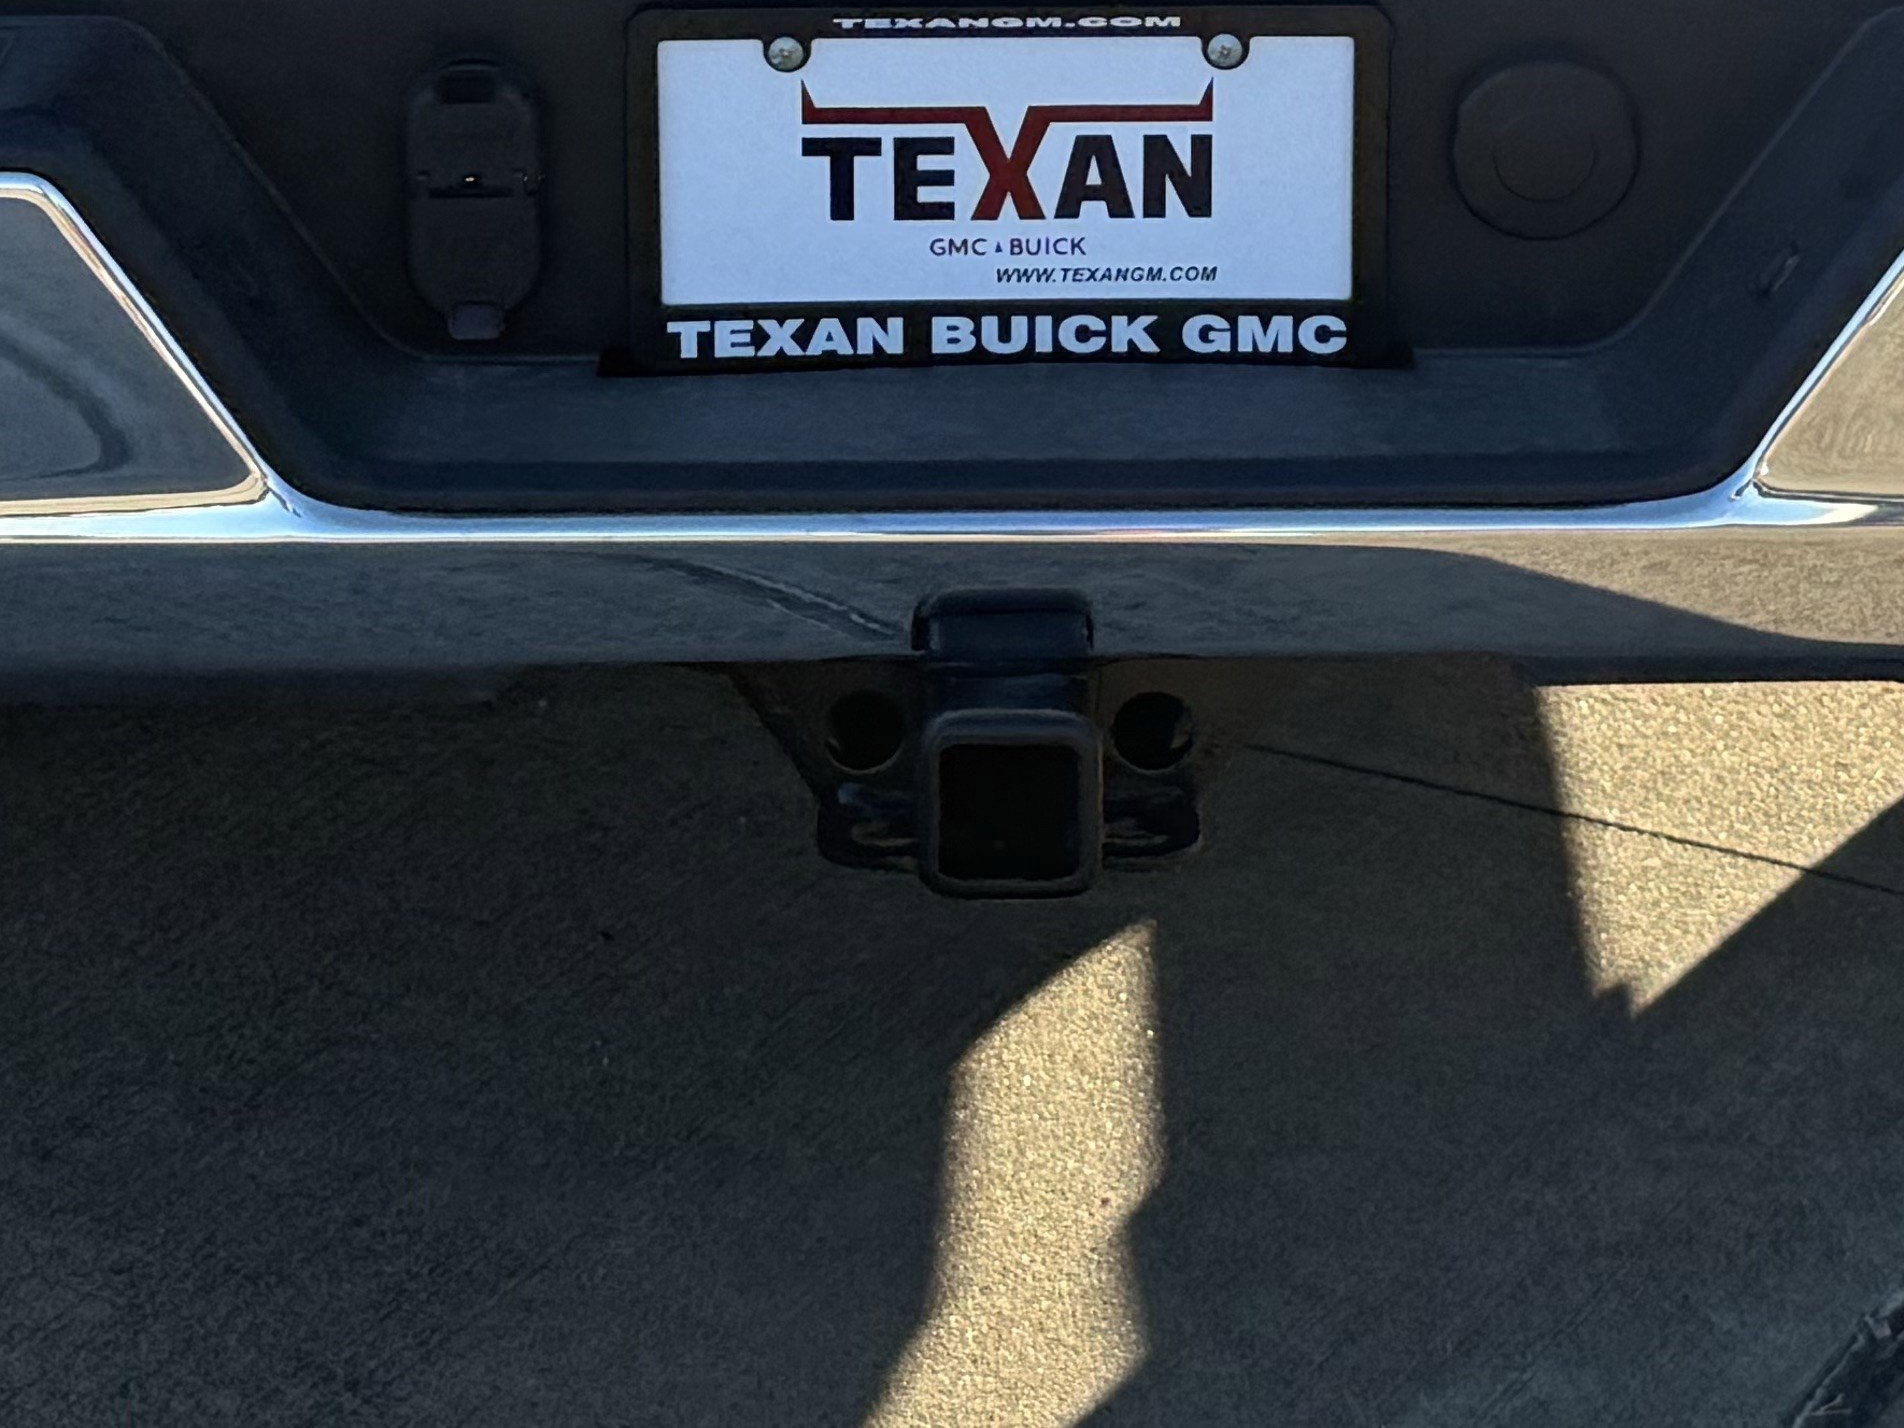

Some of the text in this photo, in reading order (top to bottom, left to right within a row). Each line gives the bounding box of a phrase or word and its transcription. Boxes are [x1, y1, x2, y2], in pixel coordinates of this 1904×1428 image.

[832, 15, 1182, 30] TEXANGM.COM
[800, 104, 1215, 223] TEXAN
[929, 236, 1088, 257] GMC BUICK
[995, 265, 1219, 284] WWW.TEXANGM.COM
[666, 314, 1348, 359] TEXAN BUICK GMC
